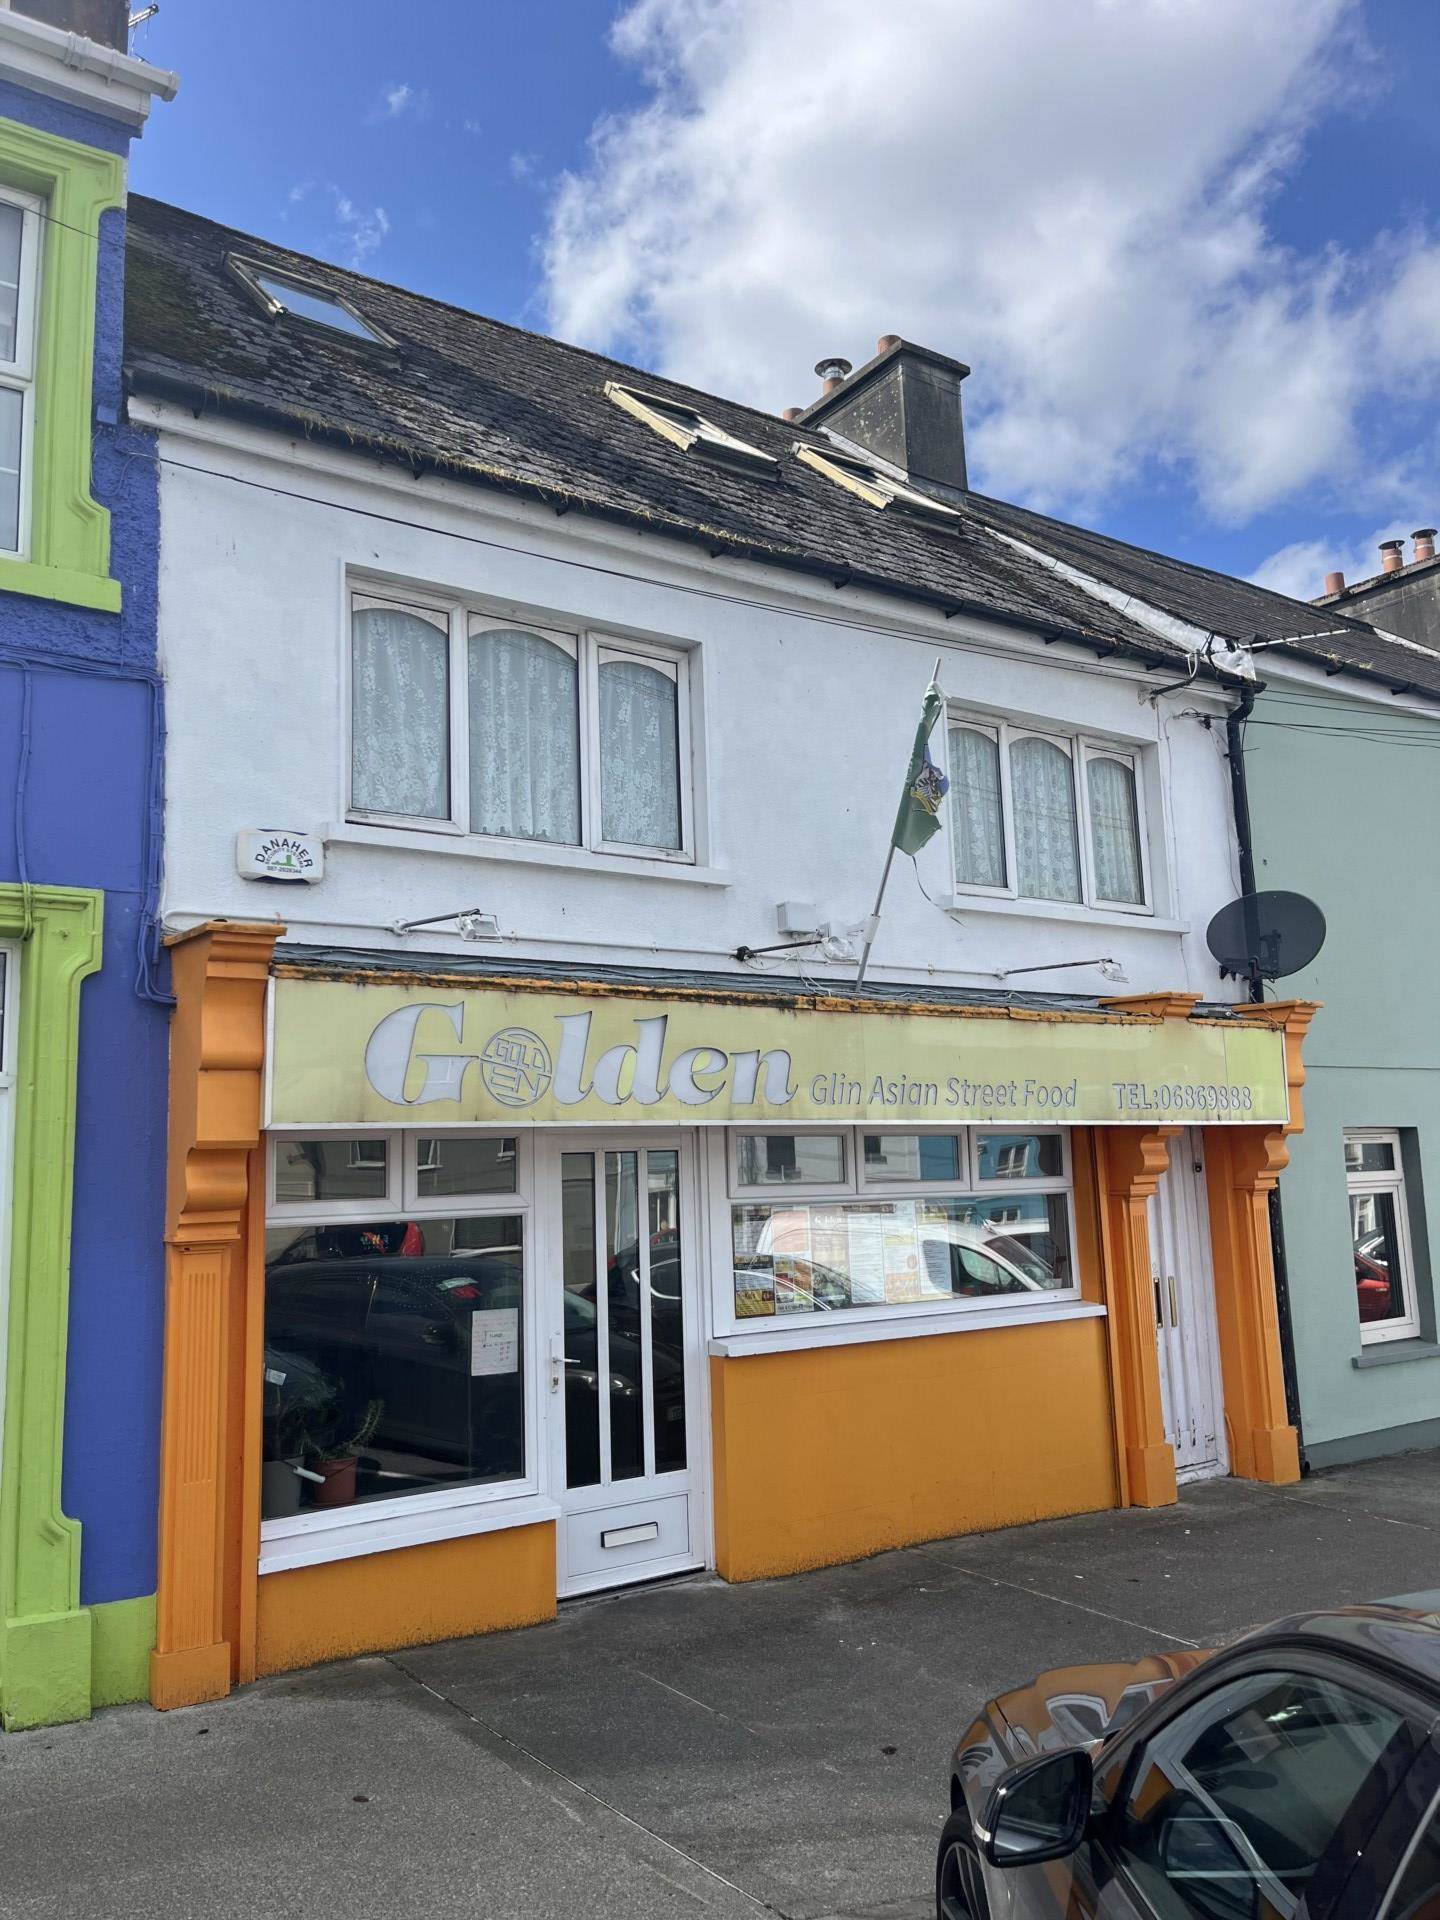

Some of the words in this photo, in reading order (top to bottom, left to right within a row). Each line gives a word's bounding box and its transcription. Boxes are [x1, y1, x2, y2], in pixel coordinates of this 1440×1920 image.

[255, 838, 313, 867] DANAHER
[364, 1001, 798, 1108] Golden
[809, 1072, 862, 1105] Glin
[869, 1074, 938, 1106] Asian
[946, 1077, 1017, 1107] Street
[1023, 1079, 1077, 1108] Food
